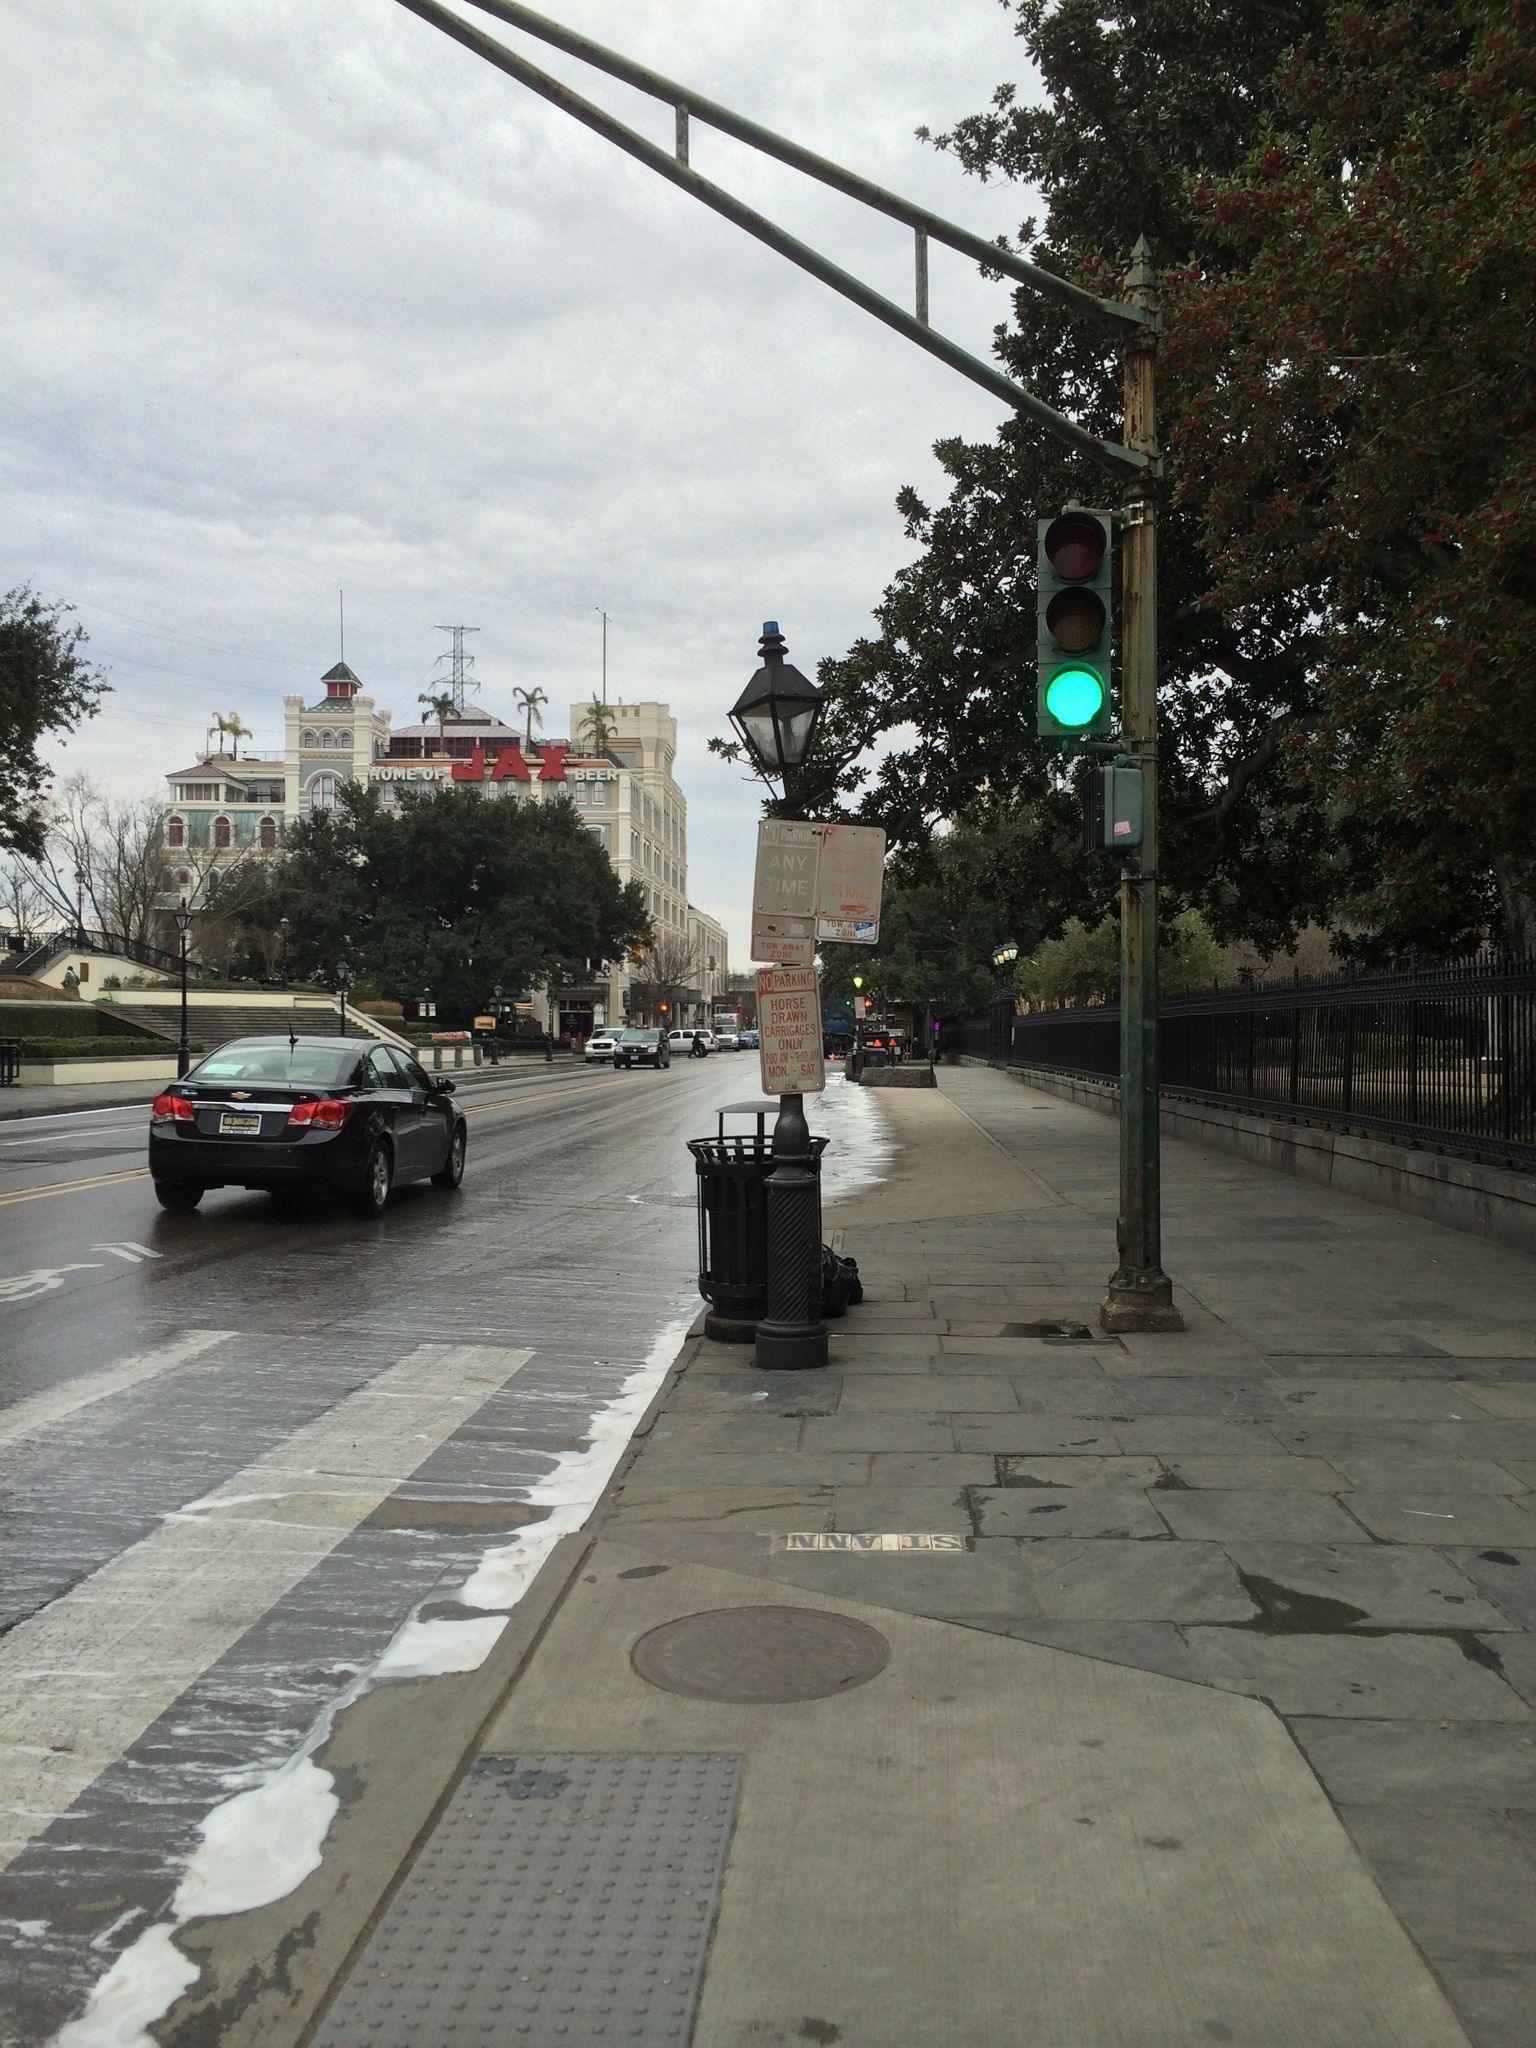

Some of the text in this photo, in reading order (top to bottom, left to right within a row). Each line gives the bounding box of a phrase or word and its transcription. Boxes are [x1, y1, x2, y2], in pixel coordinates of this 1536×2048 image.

[369, 746, 618, 782] HOME OF JAX BEER
[762, 825, 778, 842] NO
[769, 854, 808, 870] ANY
[765, 878, 809, 895] TIME
[826, 920, 843, 928] TOW
[761, 942, 805, 951] TOW AWAY
[770, 950, 793, 959] ZONE
[760, 970, 814, 991] NO PARKING
[771, 997, 807, 1011] HORSE
[771, 1011, 808, 1024] DRAWN
[778, 1037, 804, 1051] ONLY
[788, 1533, 963, 1550] ST ANN
